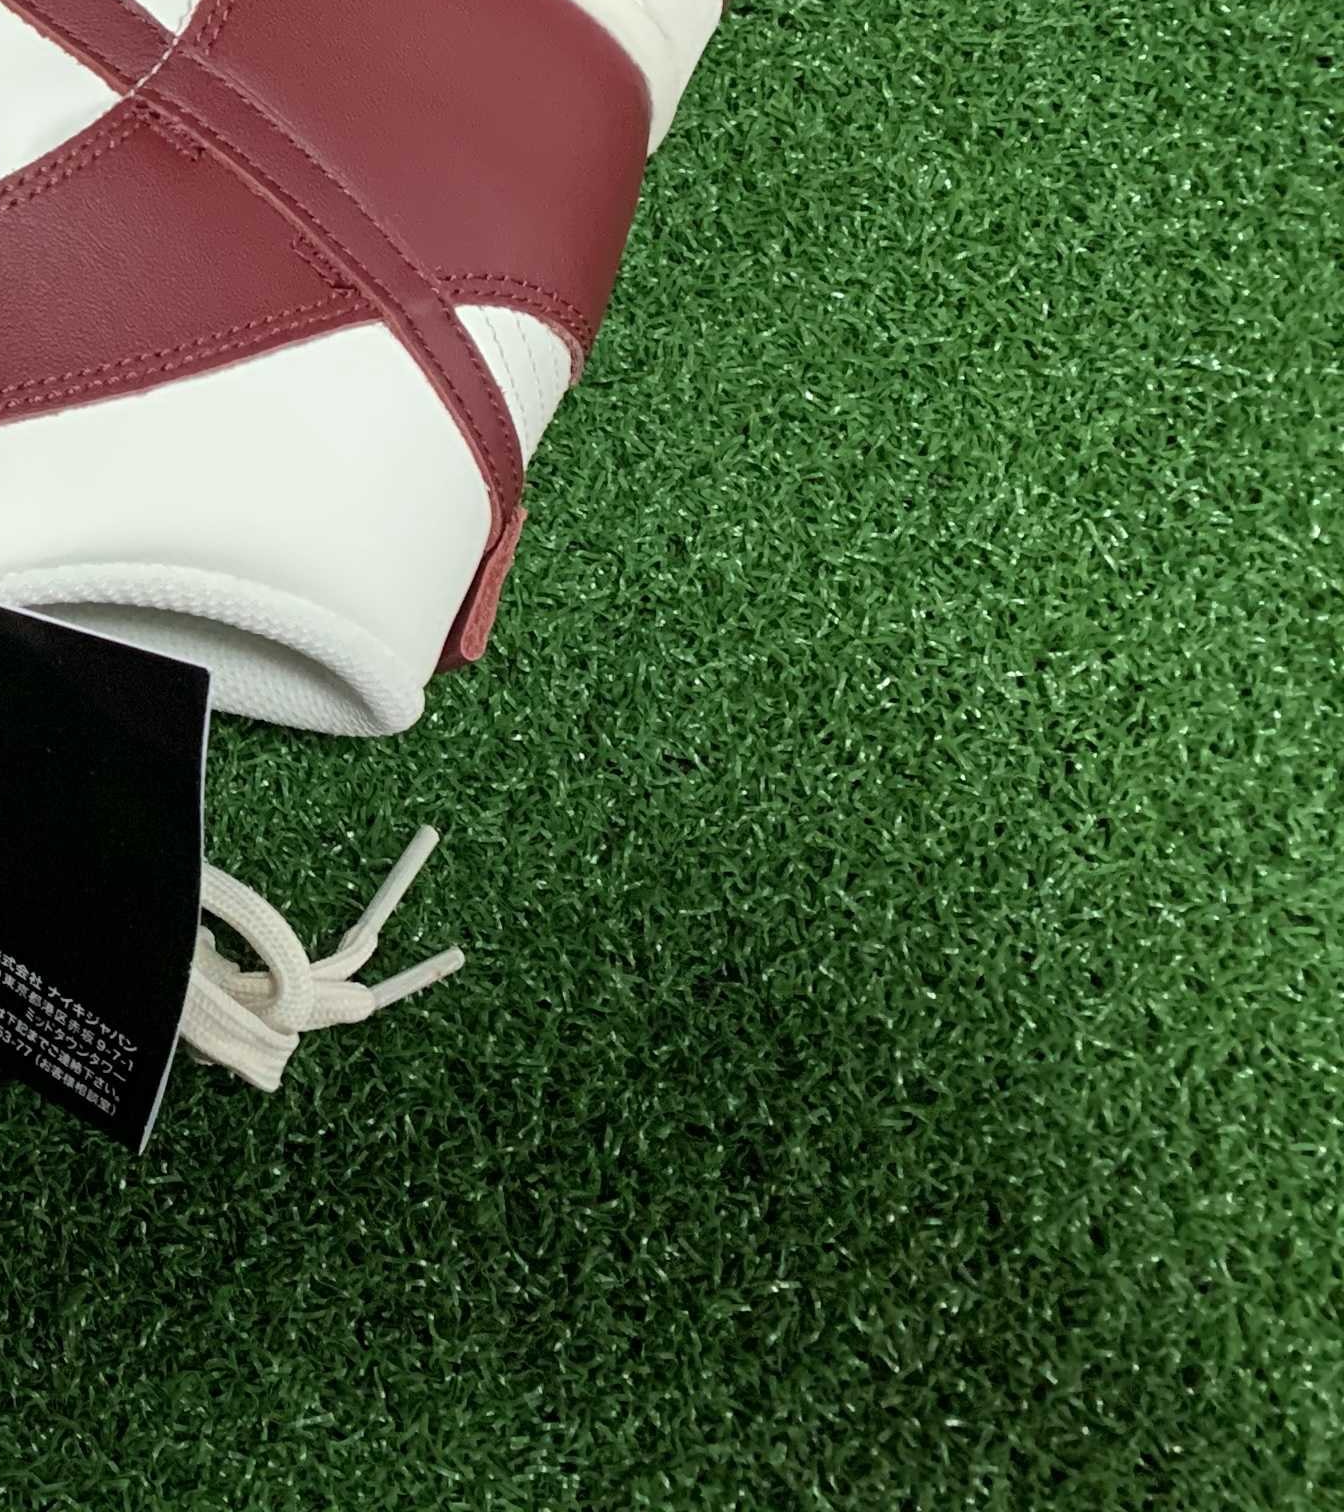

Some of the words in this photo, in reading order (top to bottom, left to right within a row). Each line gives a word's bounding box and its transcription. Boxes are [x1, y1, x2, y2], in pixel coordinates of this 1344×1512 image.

[24, 1006, 127, 1083] ミッドタウンタワー
[47, 984, 138, 1053] ナイキジャパン
